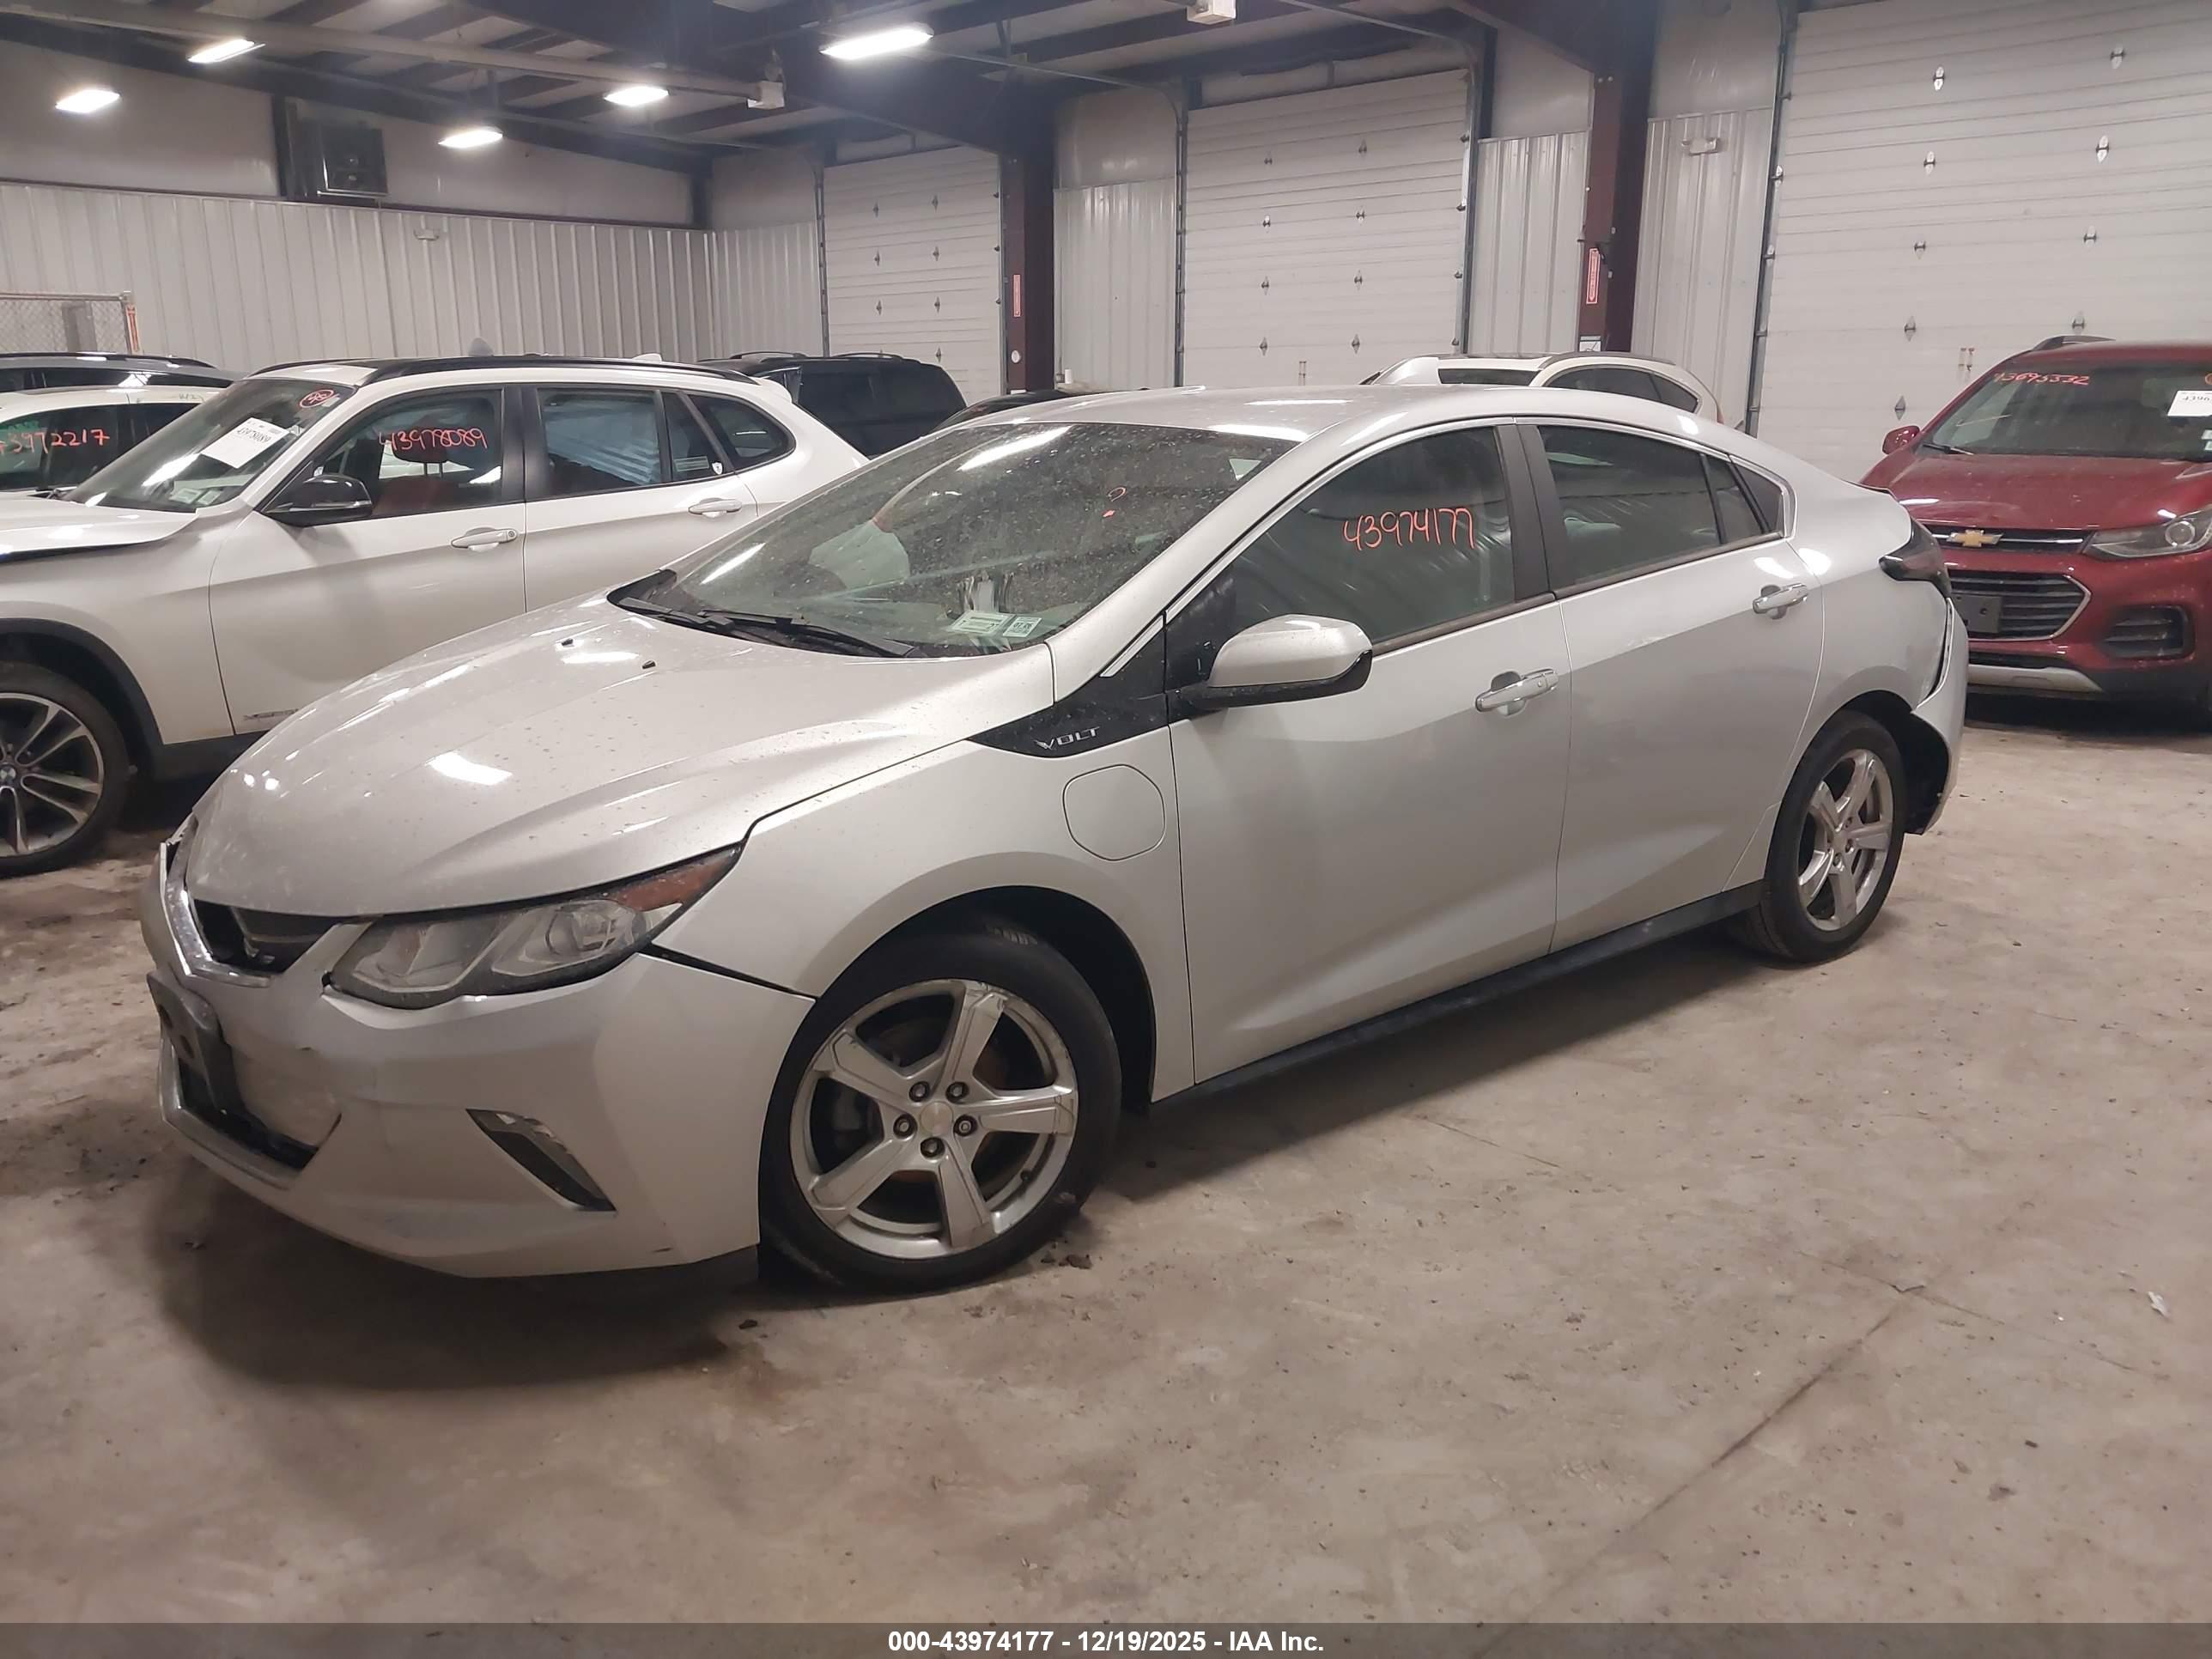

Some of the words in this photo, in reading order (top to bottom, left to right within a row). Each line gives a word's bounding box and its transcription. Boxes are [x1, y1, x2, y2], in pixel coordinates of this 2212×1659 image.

[379, 428, 489, 450] 43978089
[1343, 507, 1475, 551] 43974177
[1033, 726, 1101, 750] VOLT
